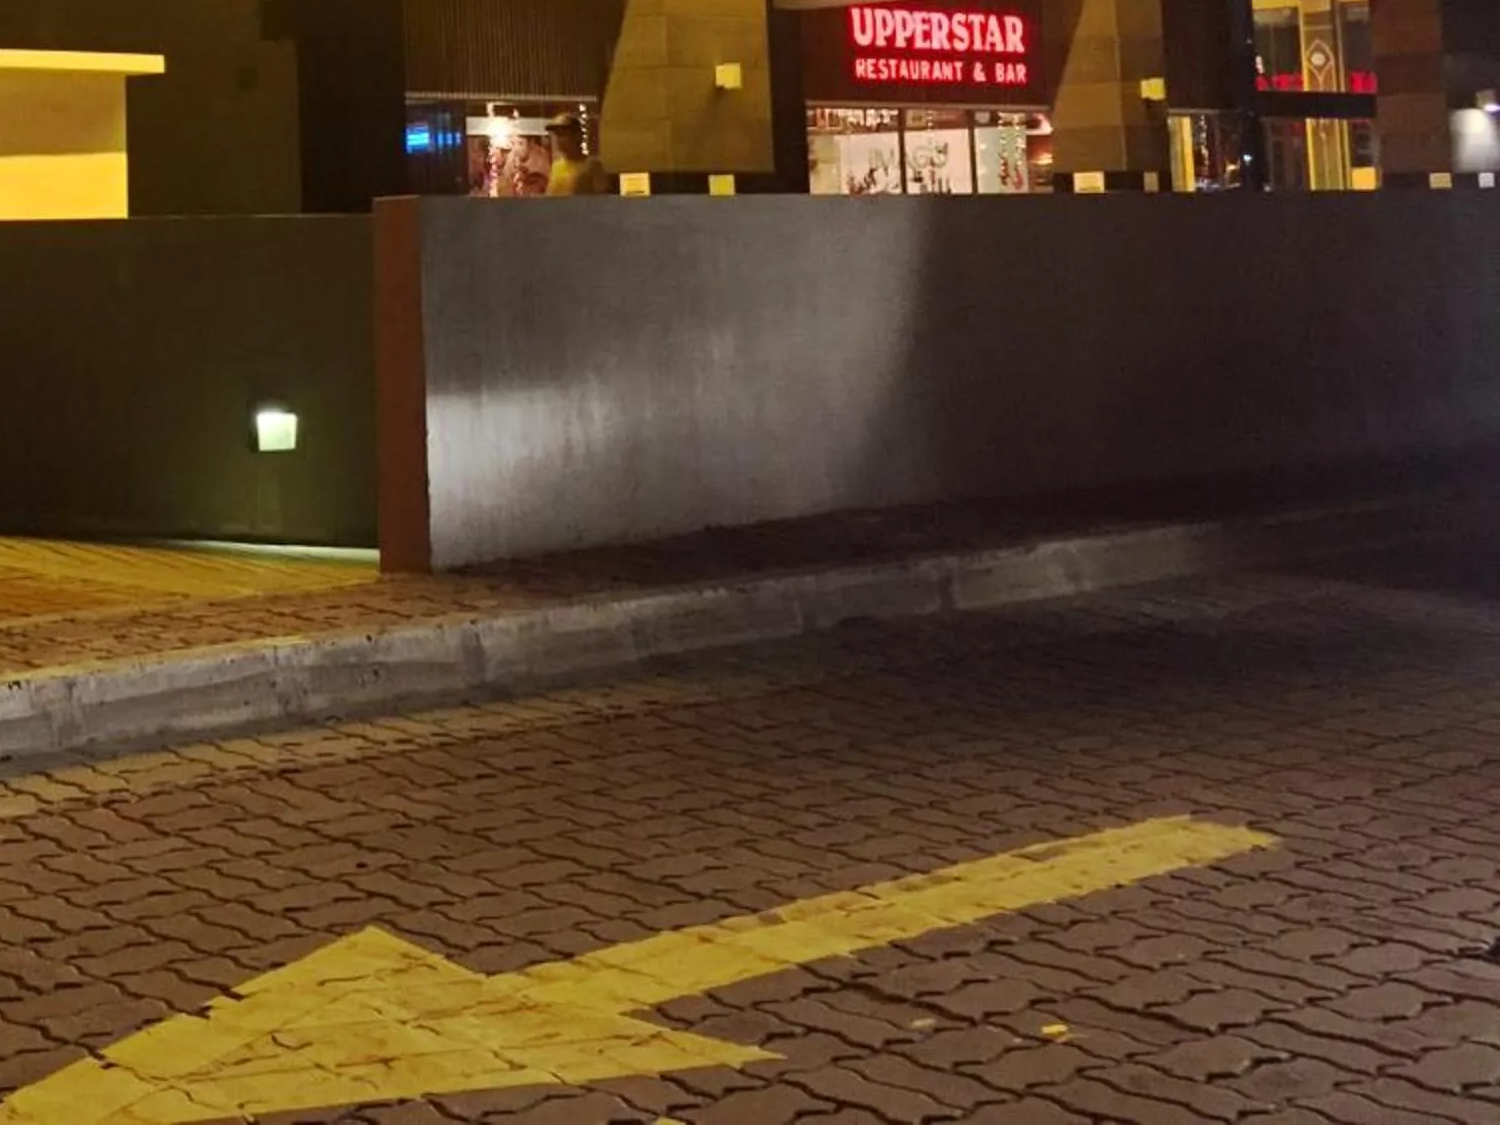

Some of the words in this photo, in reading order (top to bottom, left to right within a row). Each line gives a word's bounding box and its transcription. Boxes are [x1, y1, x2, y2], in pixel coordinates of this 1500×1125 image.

[851, 7, 1025, 53] UPPERSTAR
[855, 58, 963, 81] RESTAURANT
[972, 61, 987, 82] &
[995, 62, 1027, 84] BAR
